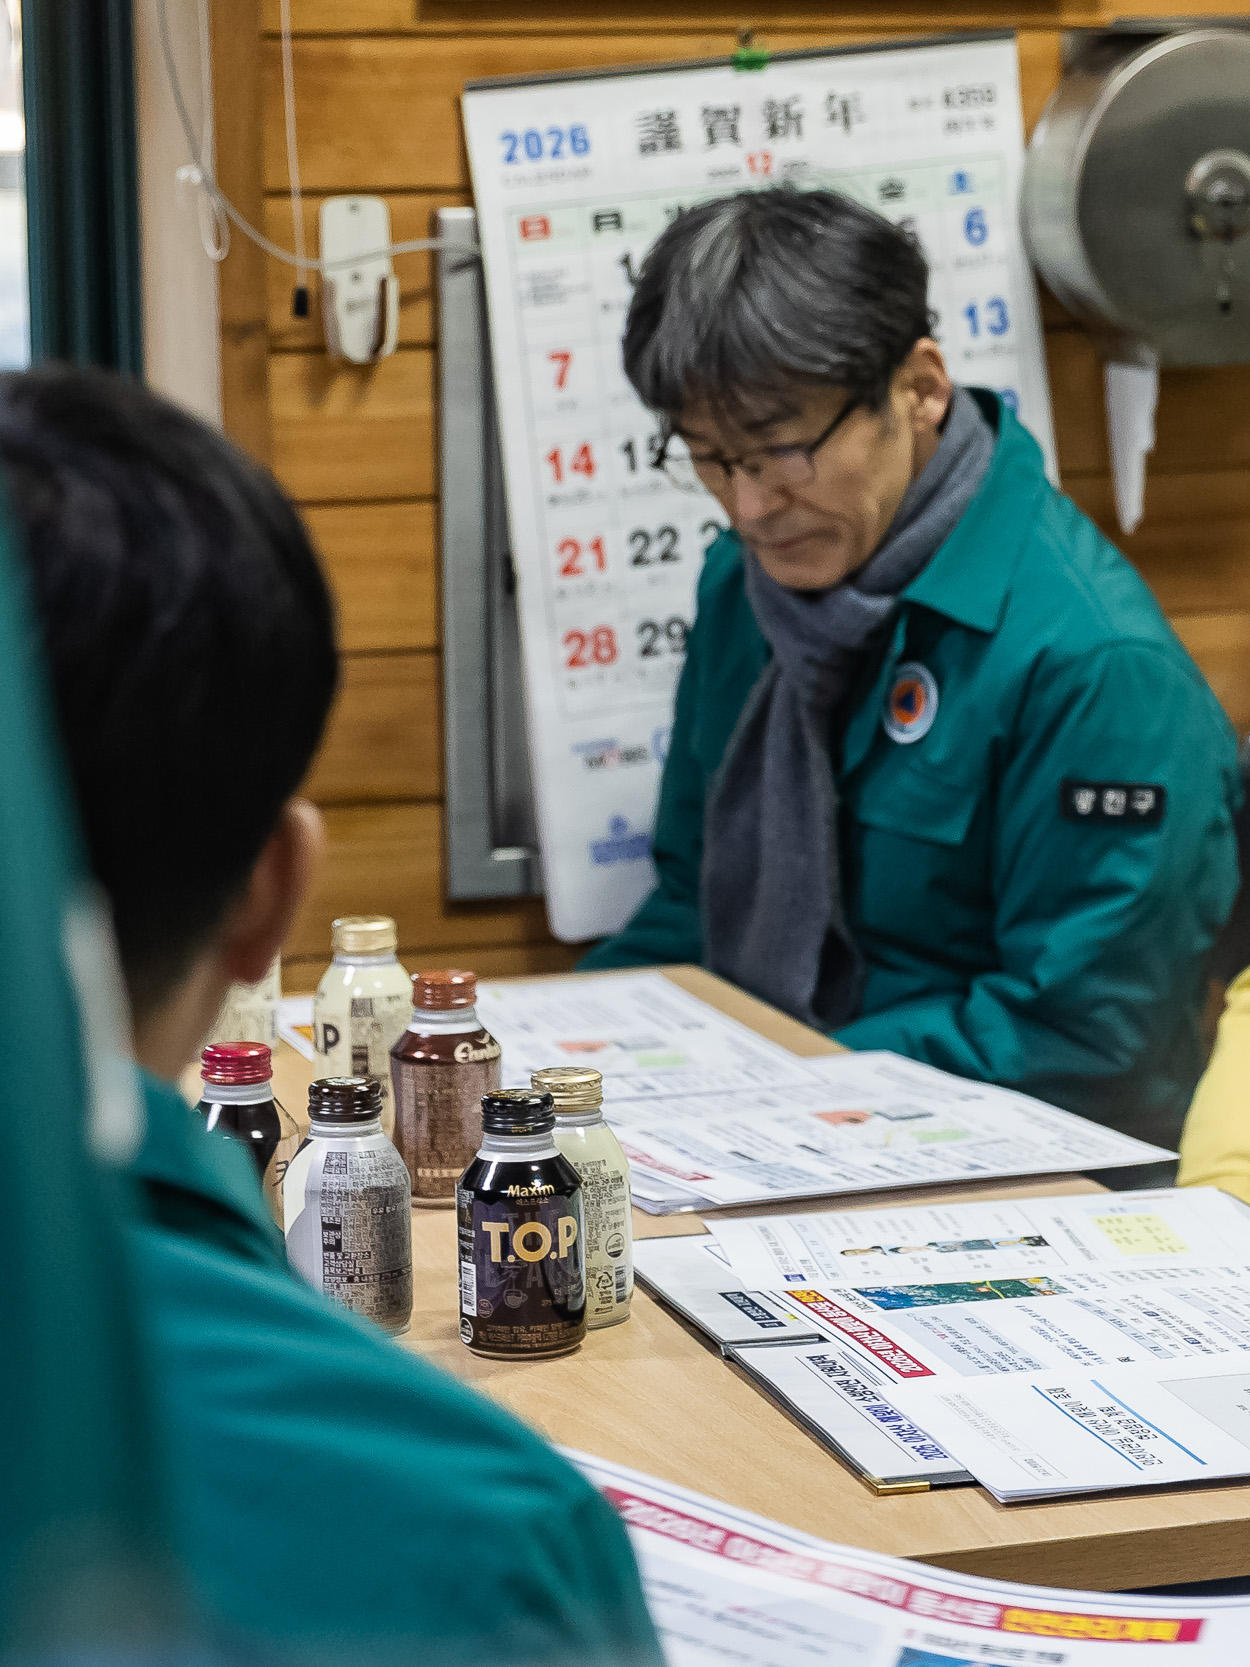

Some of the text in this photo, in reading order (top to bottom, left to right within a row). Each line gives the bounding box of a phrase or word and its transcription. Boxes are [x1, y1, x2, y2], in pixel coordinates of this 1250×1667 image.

[634, 90, 866, 156] 謹賀新年
[500, 123, 592, 164] 2026
[746, 151, 772, 175] 12
[879, 176, 905, 201] 金
[520, 215, 551, 241] 日
[594, 212, 622, 232] 月
[964, 207, 989, 246] 6
[964, 296, 1010, 336] 13
[549, 351, 573, 389] 7
[546, 442, 595, 483] 14
[557, 536, 606, 577] 21
[629, 525, 682, 567] 22
[563, 625, 619, 668] 28
[637, 616, 687, 659] 29
[506, 1184, 555, 1198] Maxim
[481, 1215, 578, 1263] T.O.P
[851, 1331, 895, 1350] 아차산
[876, 1345, 924, 1373] 2026년
[805, 1354, 949, 1461] 2026 아차산 해맞이 소방안전 지원대책
